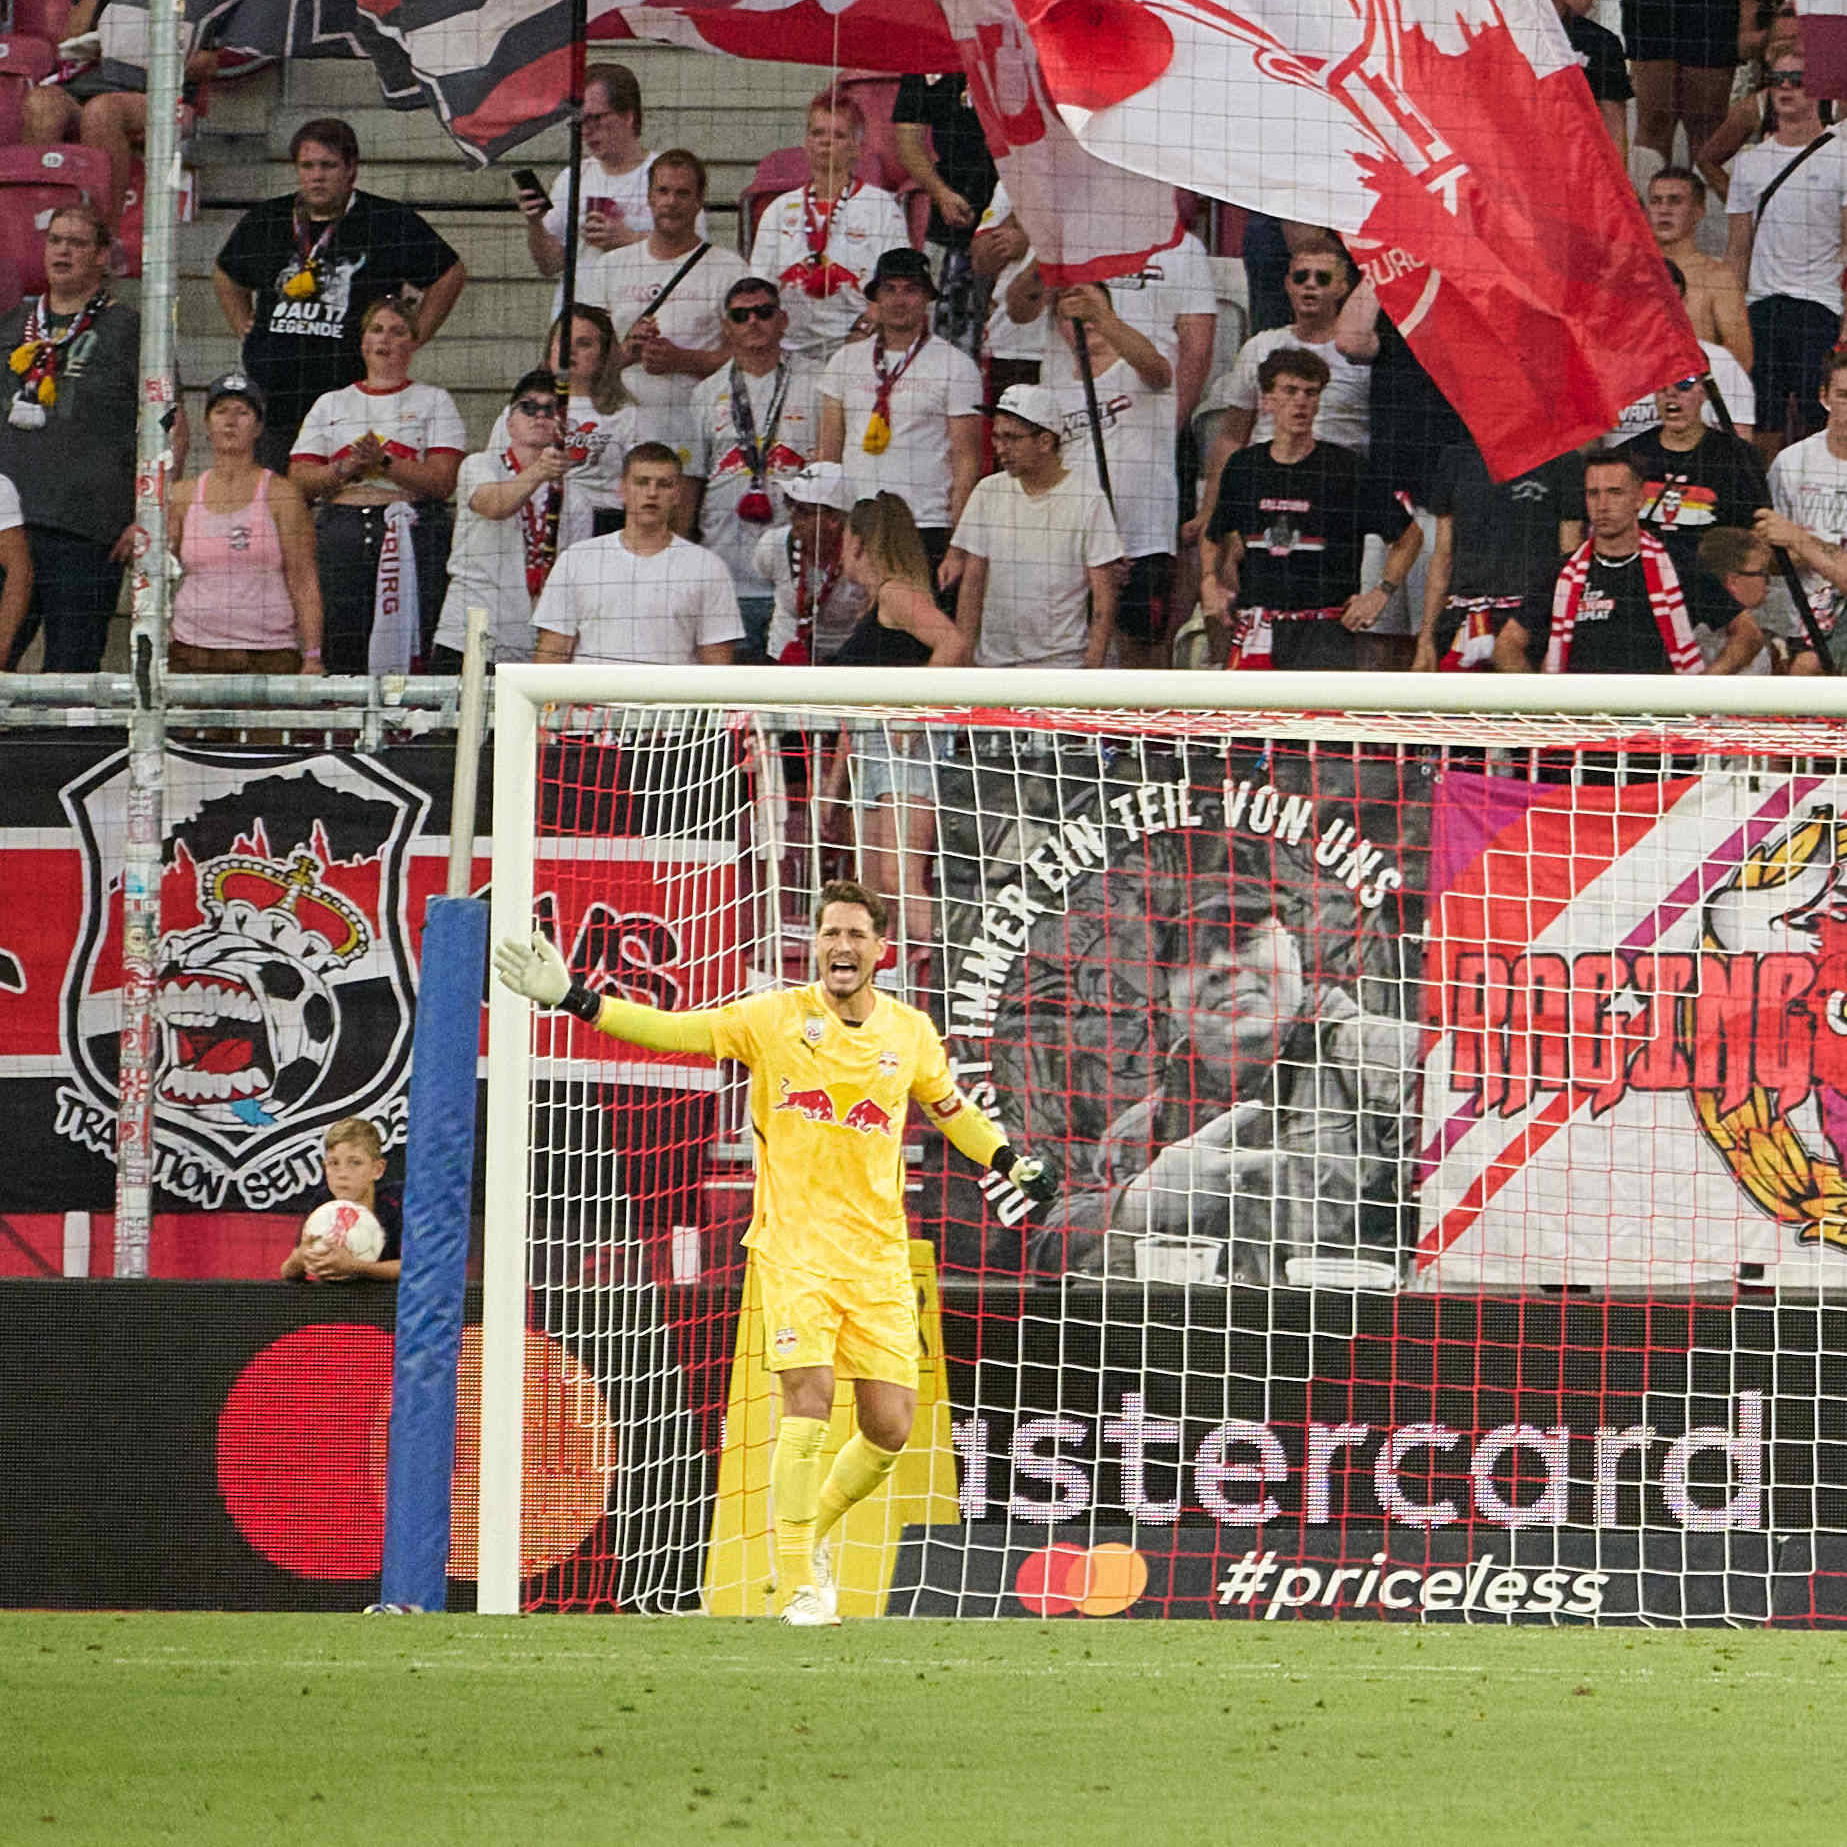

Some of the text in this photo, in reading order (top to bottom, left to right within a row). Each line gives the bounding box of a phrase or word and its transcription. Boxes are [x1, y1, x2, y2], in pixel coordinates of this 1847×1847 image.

[270, 318, 344, 339] LEGENDE
[950, 884, 1046, 1038] IMMER
[1025, 815, 1109, 897] EIN
[1110, 779, 1201, 844] TEIL
[1221, 778, 1314, 848] VON
[1313, 818, 1402, 911] UNS
[952, 1389, 1763, 1532] stercard
[1218, 1547, 1609, 1625] #priceless
